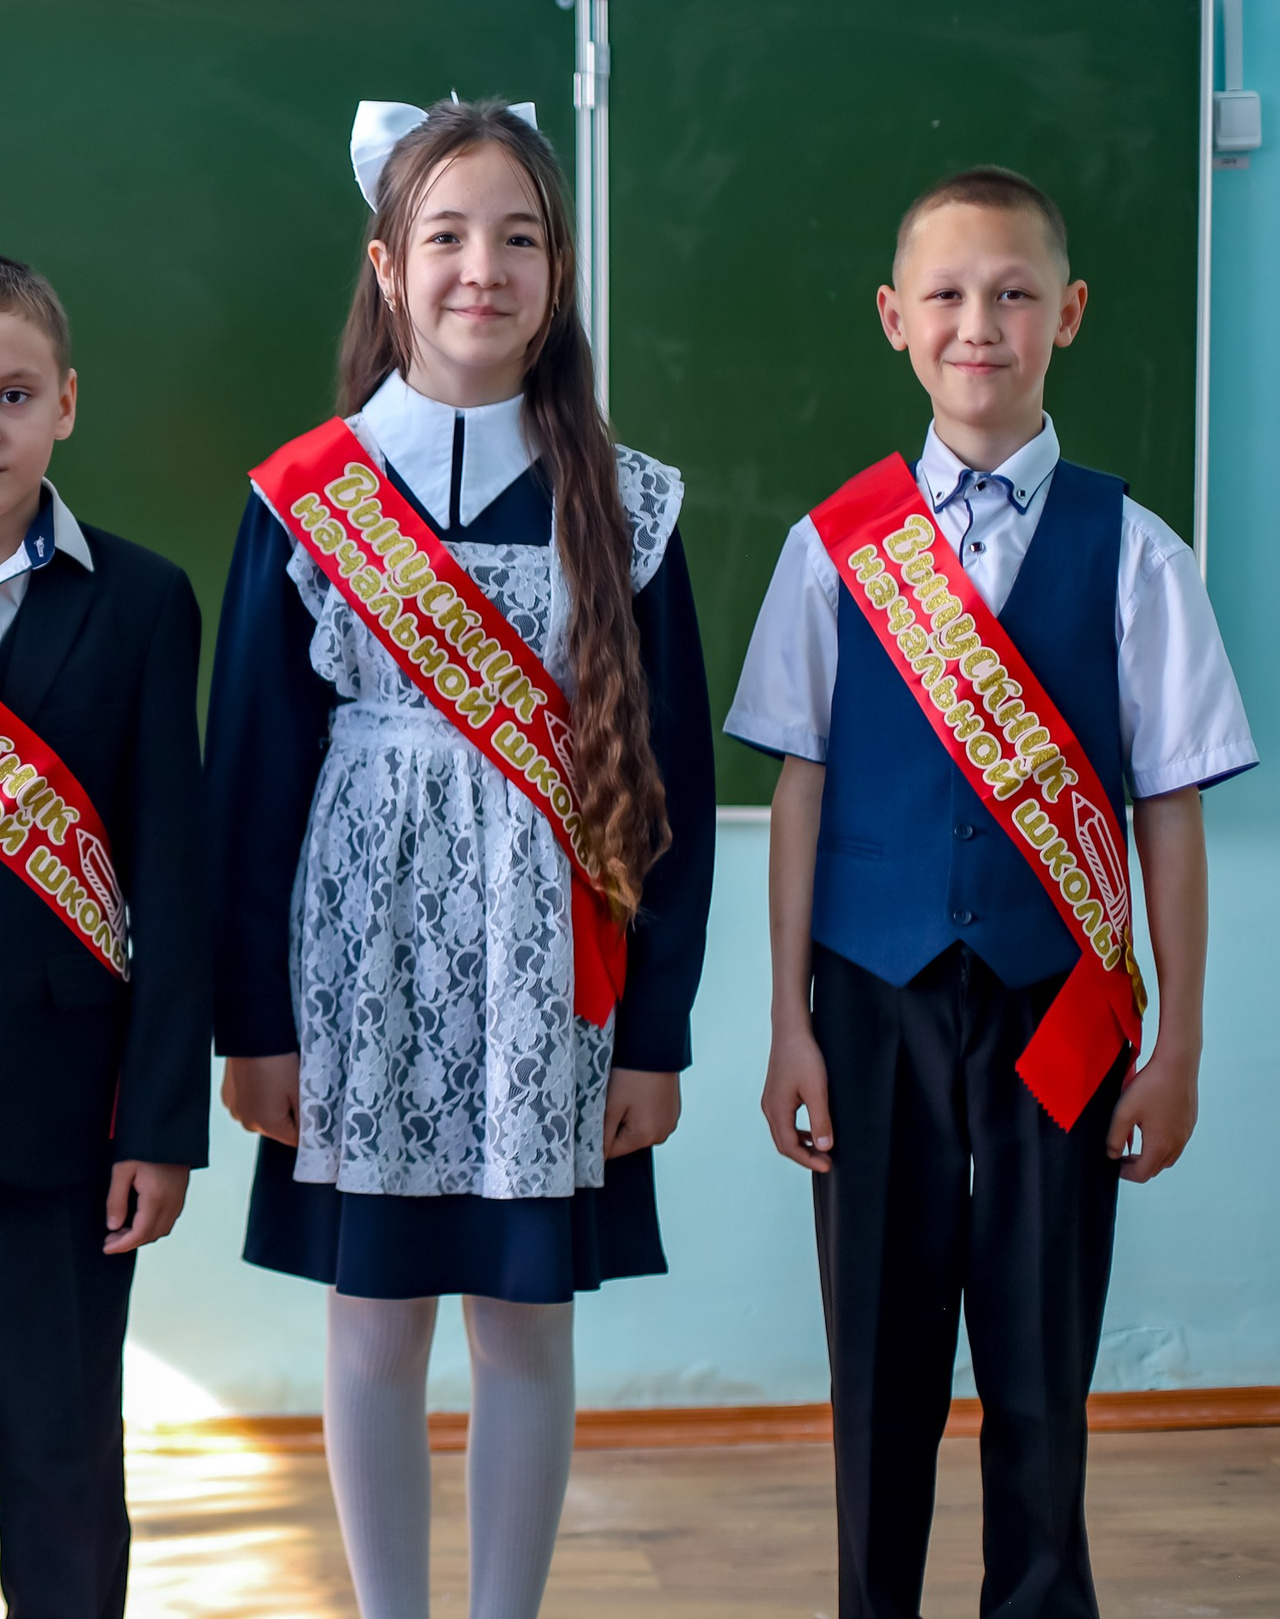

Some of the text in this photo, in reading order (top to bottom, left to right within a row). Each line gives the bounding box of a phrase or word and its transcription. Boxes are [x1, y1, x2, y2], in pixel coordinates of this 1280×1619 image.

[290, 492, 499, 729] начальной
[324, 461, 547, 724] Выпускник
[882, 514, 1079, 803] Выпускник
[848, 544, 1121, 971] начальной школы
